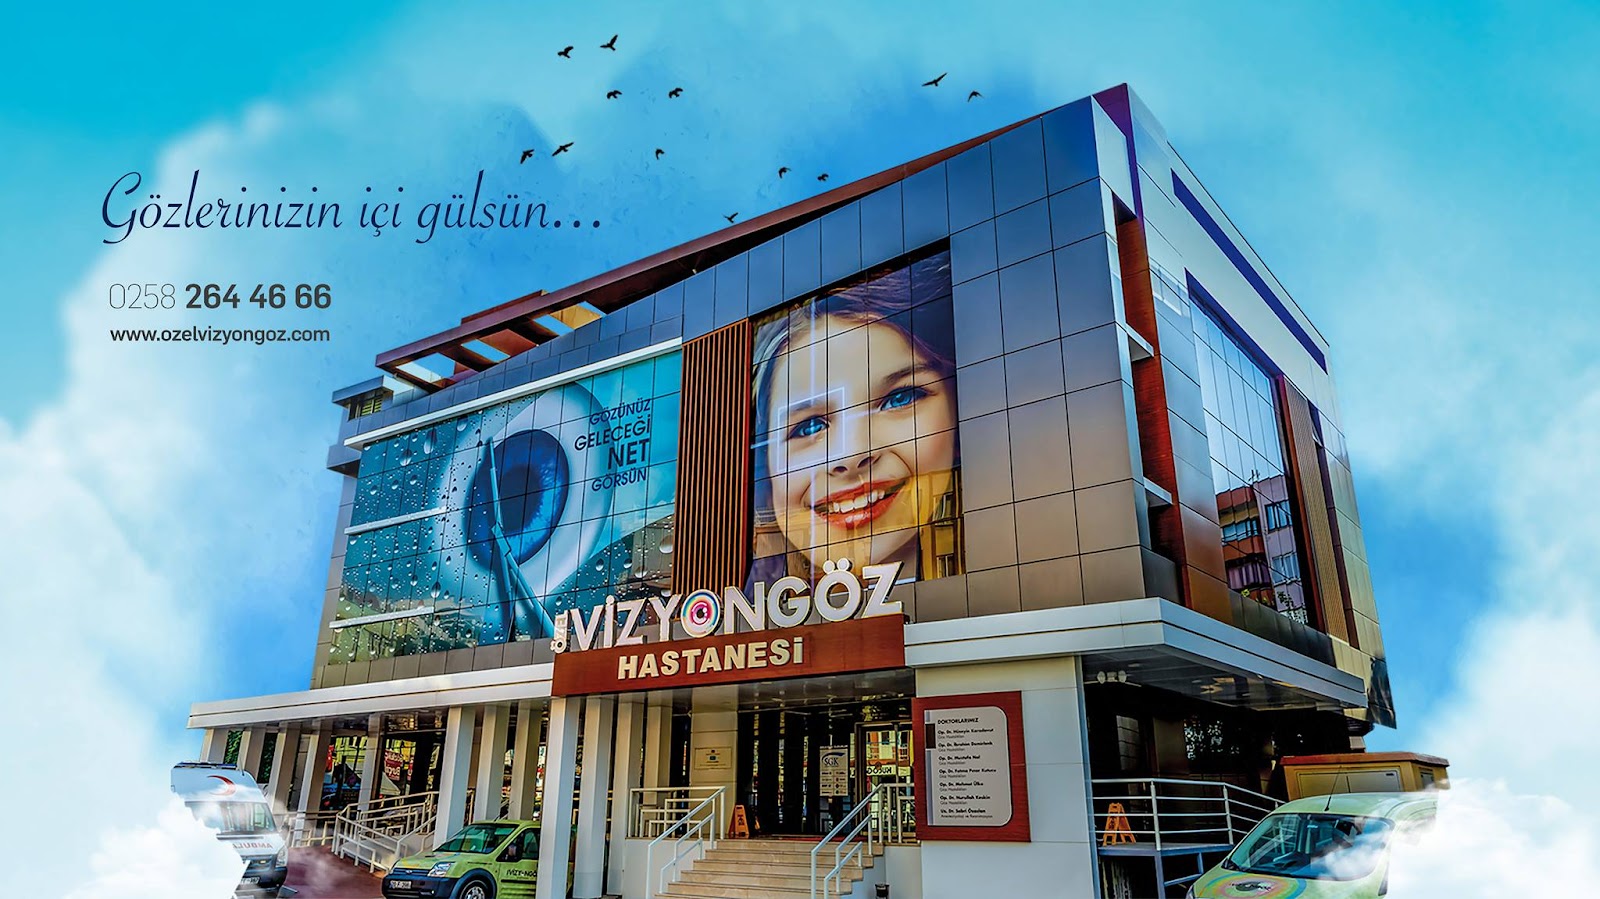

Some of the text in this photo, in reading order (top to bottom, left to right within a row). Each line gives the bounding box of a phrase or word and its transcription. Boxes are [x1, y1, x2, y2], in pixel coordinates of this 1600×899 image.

[589, 397, 651, 426] GÖZÜNÜZ
[574, 414, 651, 451] GELECEĞİ
[607, 438, 650, 470] NET
[591, 467, 647, 492] GÖRSÜN
[617, 636, 803, 680] HASTANESİ
[937, 717, 979, 725] DOKTORLARIMIZ
[824, 757, 839, 766] SGK
